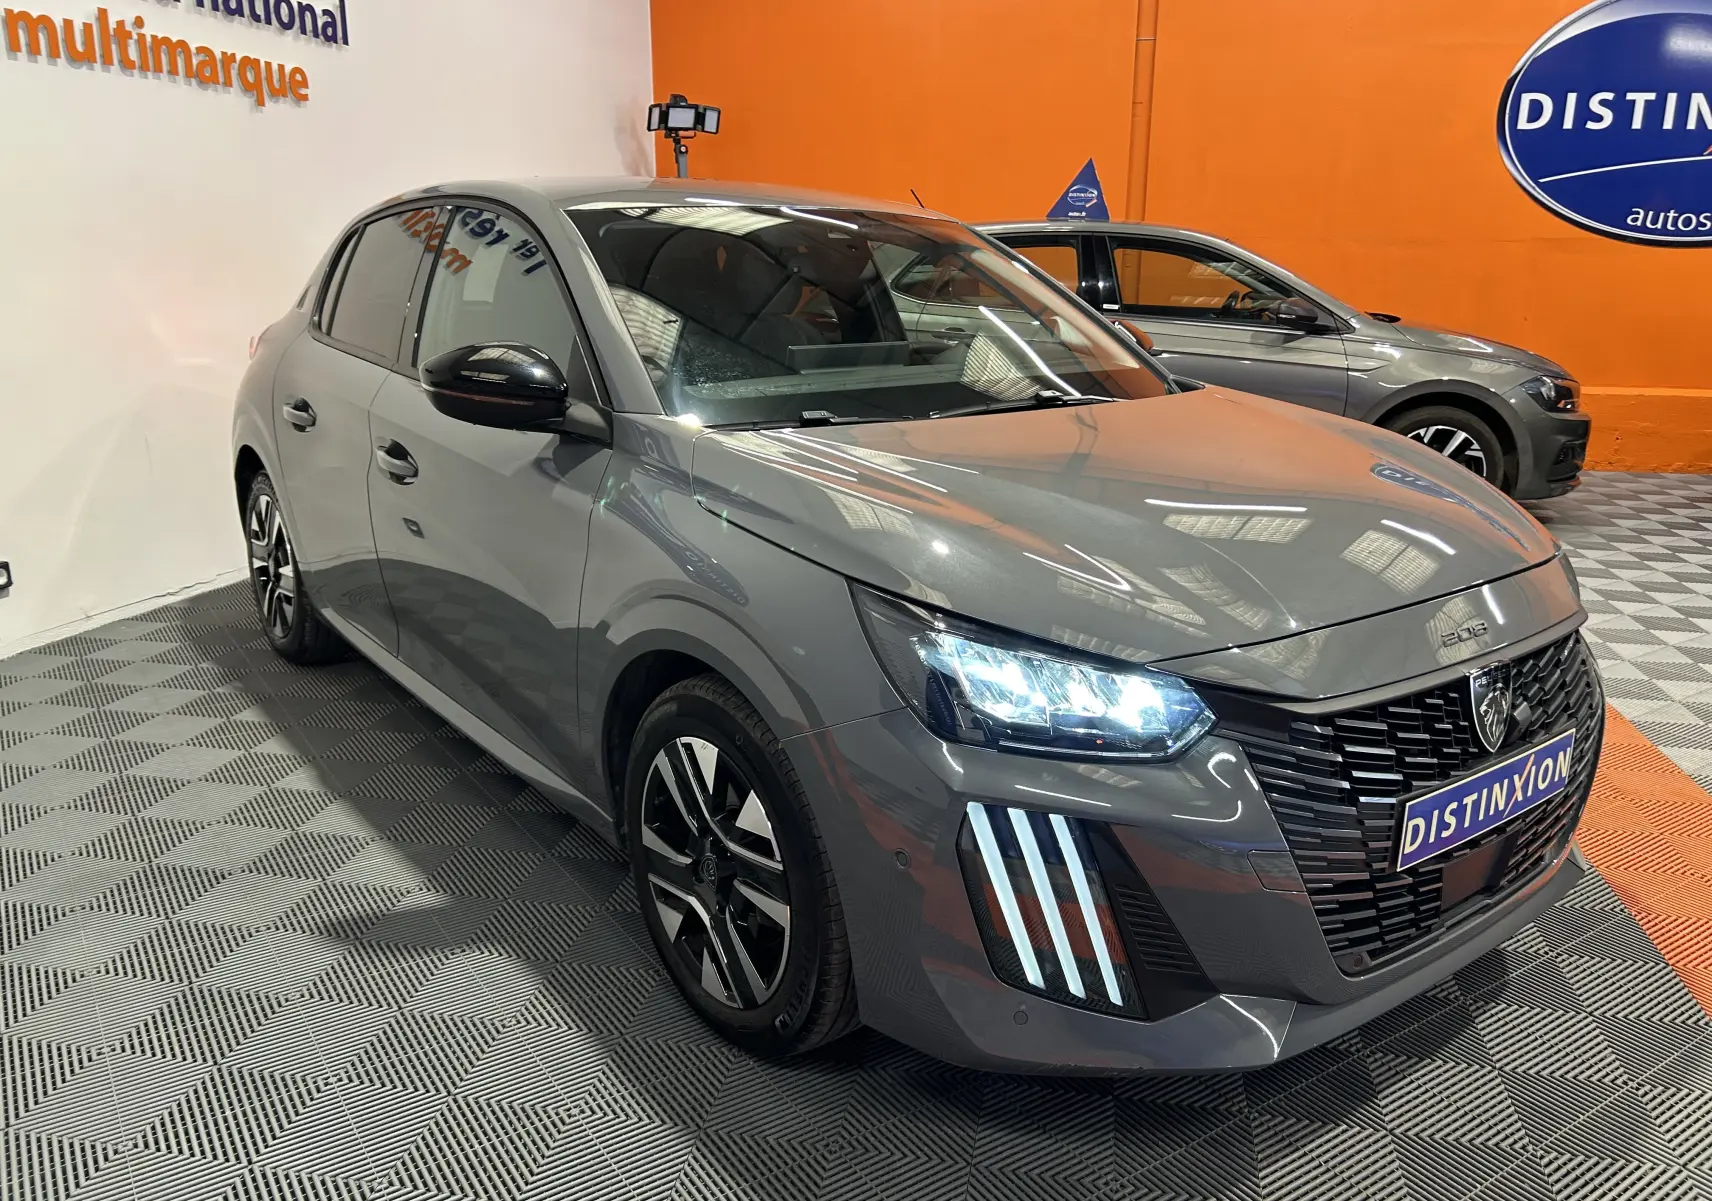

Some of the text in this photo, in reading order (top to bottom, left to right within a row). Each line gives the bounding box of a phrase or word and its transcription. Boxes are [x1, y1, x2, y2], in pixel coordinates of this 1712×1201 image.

[4, 7, 309, 107] multimarque
[1627, 207, 1712, 231] autos
[1441, 620, 1488, 647] 208
[1403, 746, 1571, 855] DISTINXION
